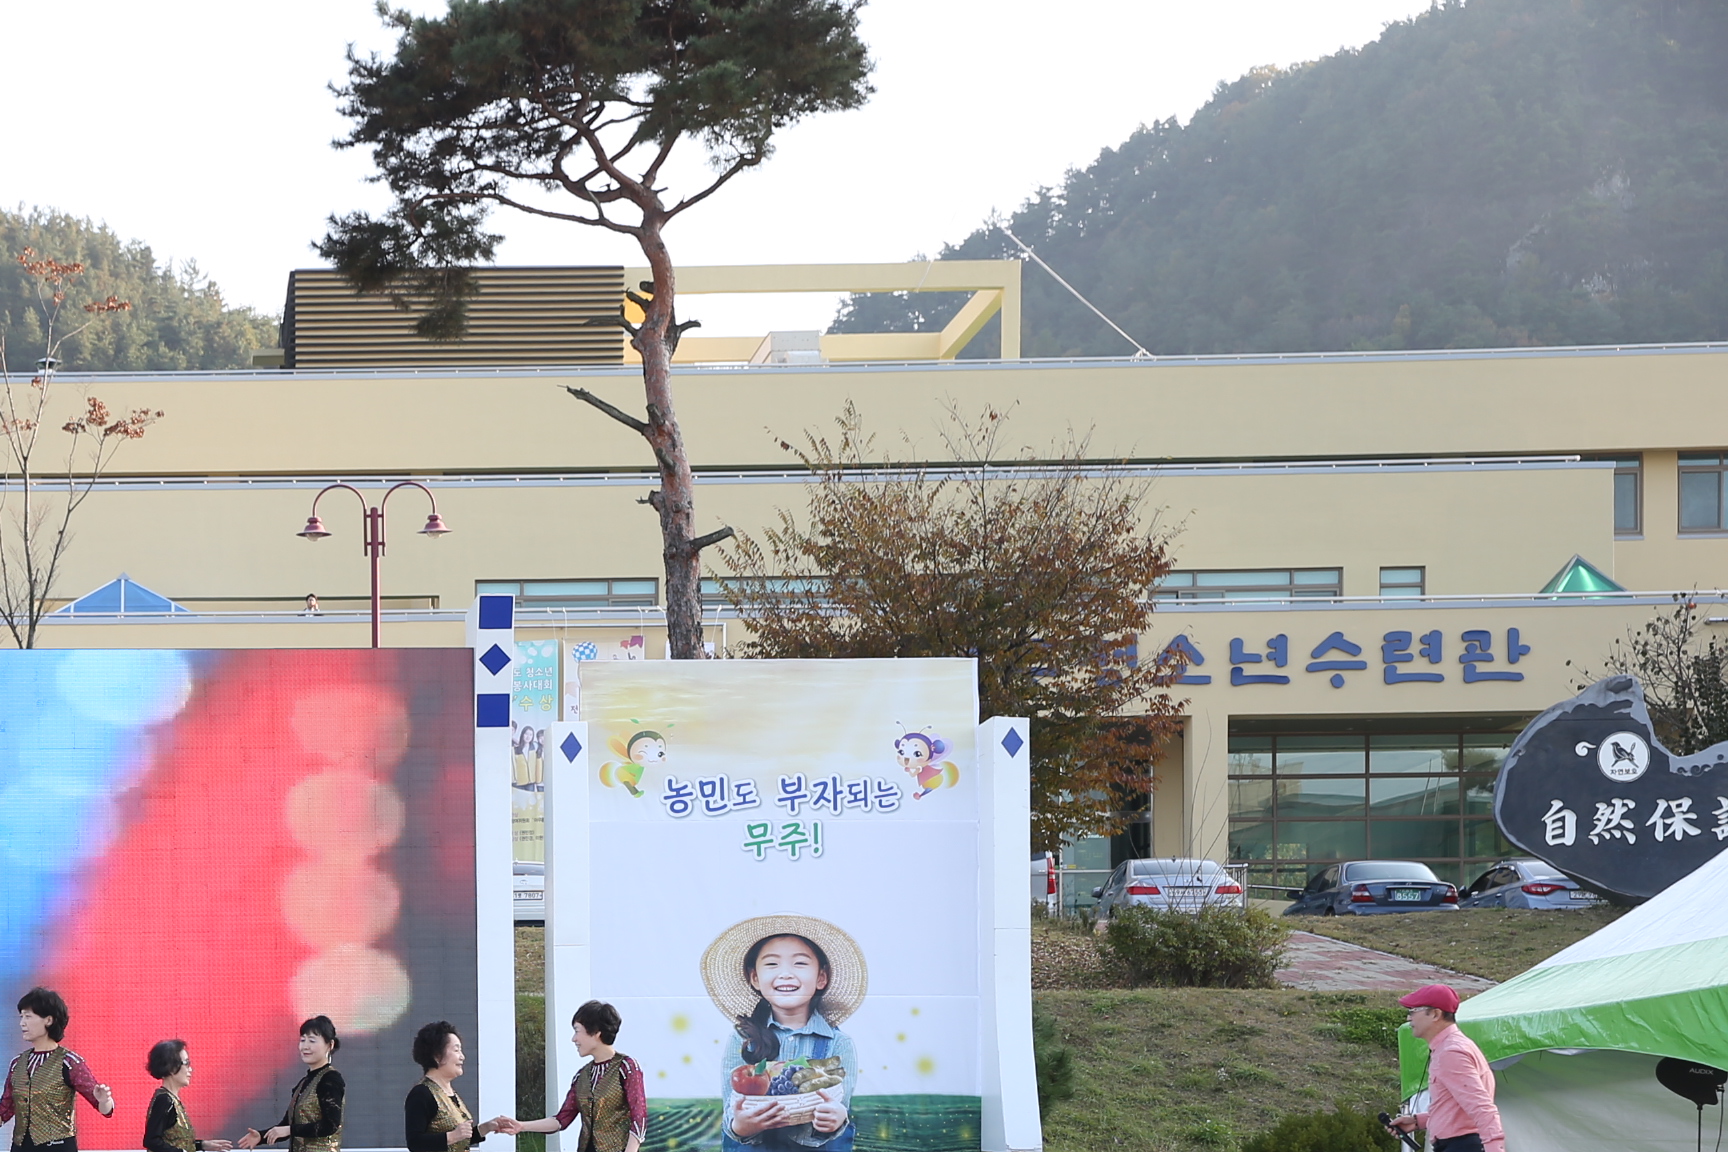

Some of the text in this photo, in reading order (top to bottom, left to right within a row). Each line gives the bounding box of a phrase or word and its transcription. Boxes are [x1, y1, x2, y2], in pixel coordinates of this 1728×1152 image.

[526, 666, 553, 678] 청소년
[513, 679, 553, 692] 봉사대회
[1610, 768, 1638, 776] 자연보호
[663, 775, 899, 814] 농민도 부자되는
[743, 821, 821, 857] 무주!
[1689, 1067, 1714, 1075] AUDIX
